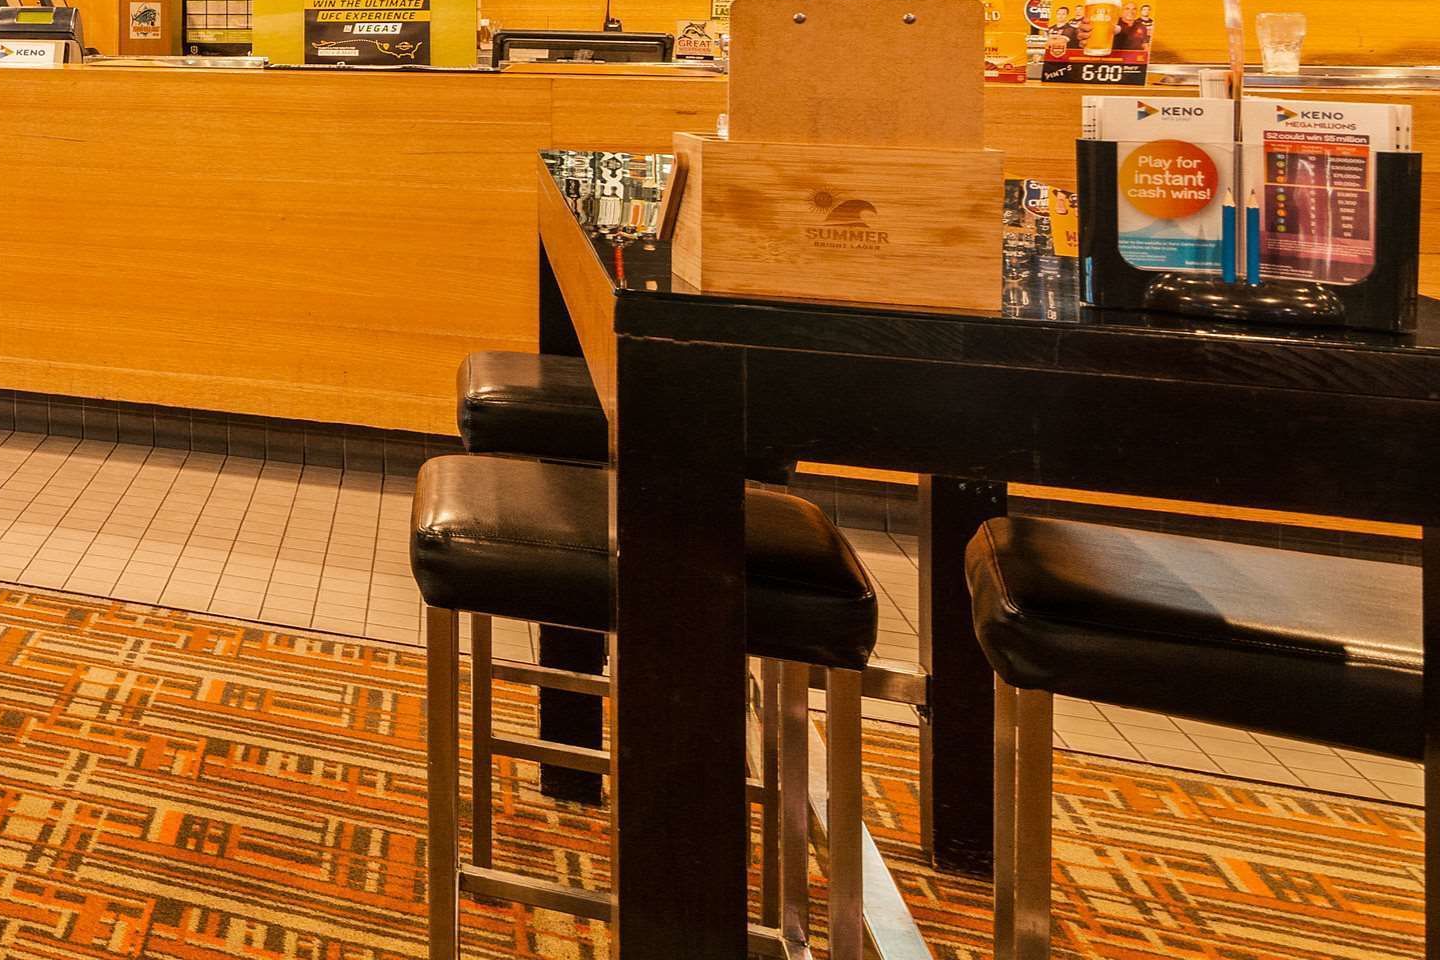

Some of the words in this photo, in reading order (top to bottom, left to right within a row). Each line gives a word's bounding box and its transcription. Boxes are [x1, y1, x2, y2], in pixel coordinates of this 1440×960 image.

[313, 0, 337, 8] WIN
[340, 0, 361, 8] THE
[364, 0, 421, 8] ULTIMATE
[321, 12, 342, 20] UFC
[345, 11, 416, 20] EXPERIENCE
[358, 24, 398, 33] VEGAS
[678, 40, 712, 48] GREAT
[1161, 107, 1204, 117] KENO
[1301, 111, 1344, 120] KENO
[1314, 122, 1357, 131] MILLIONS
[1336, 135, 1368, 144] million
[1138, 155, 1172, 170] Play
[1176, 156, 1201, 169] for
[1134, 170, 1205, 187] instant
[1127, 186, 1166, 198] cash
[1170, 188, 1211, 200] wins!
[805, 227, 889, 245] SUMMER
[851, 243, 881, 251] LAGER
